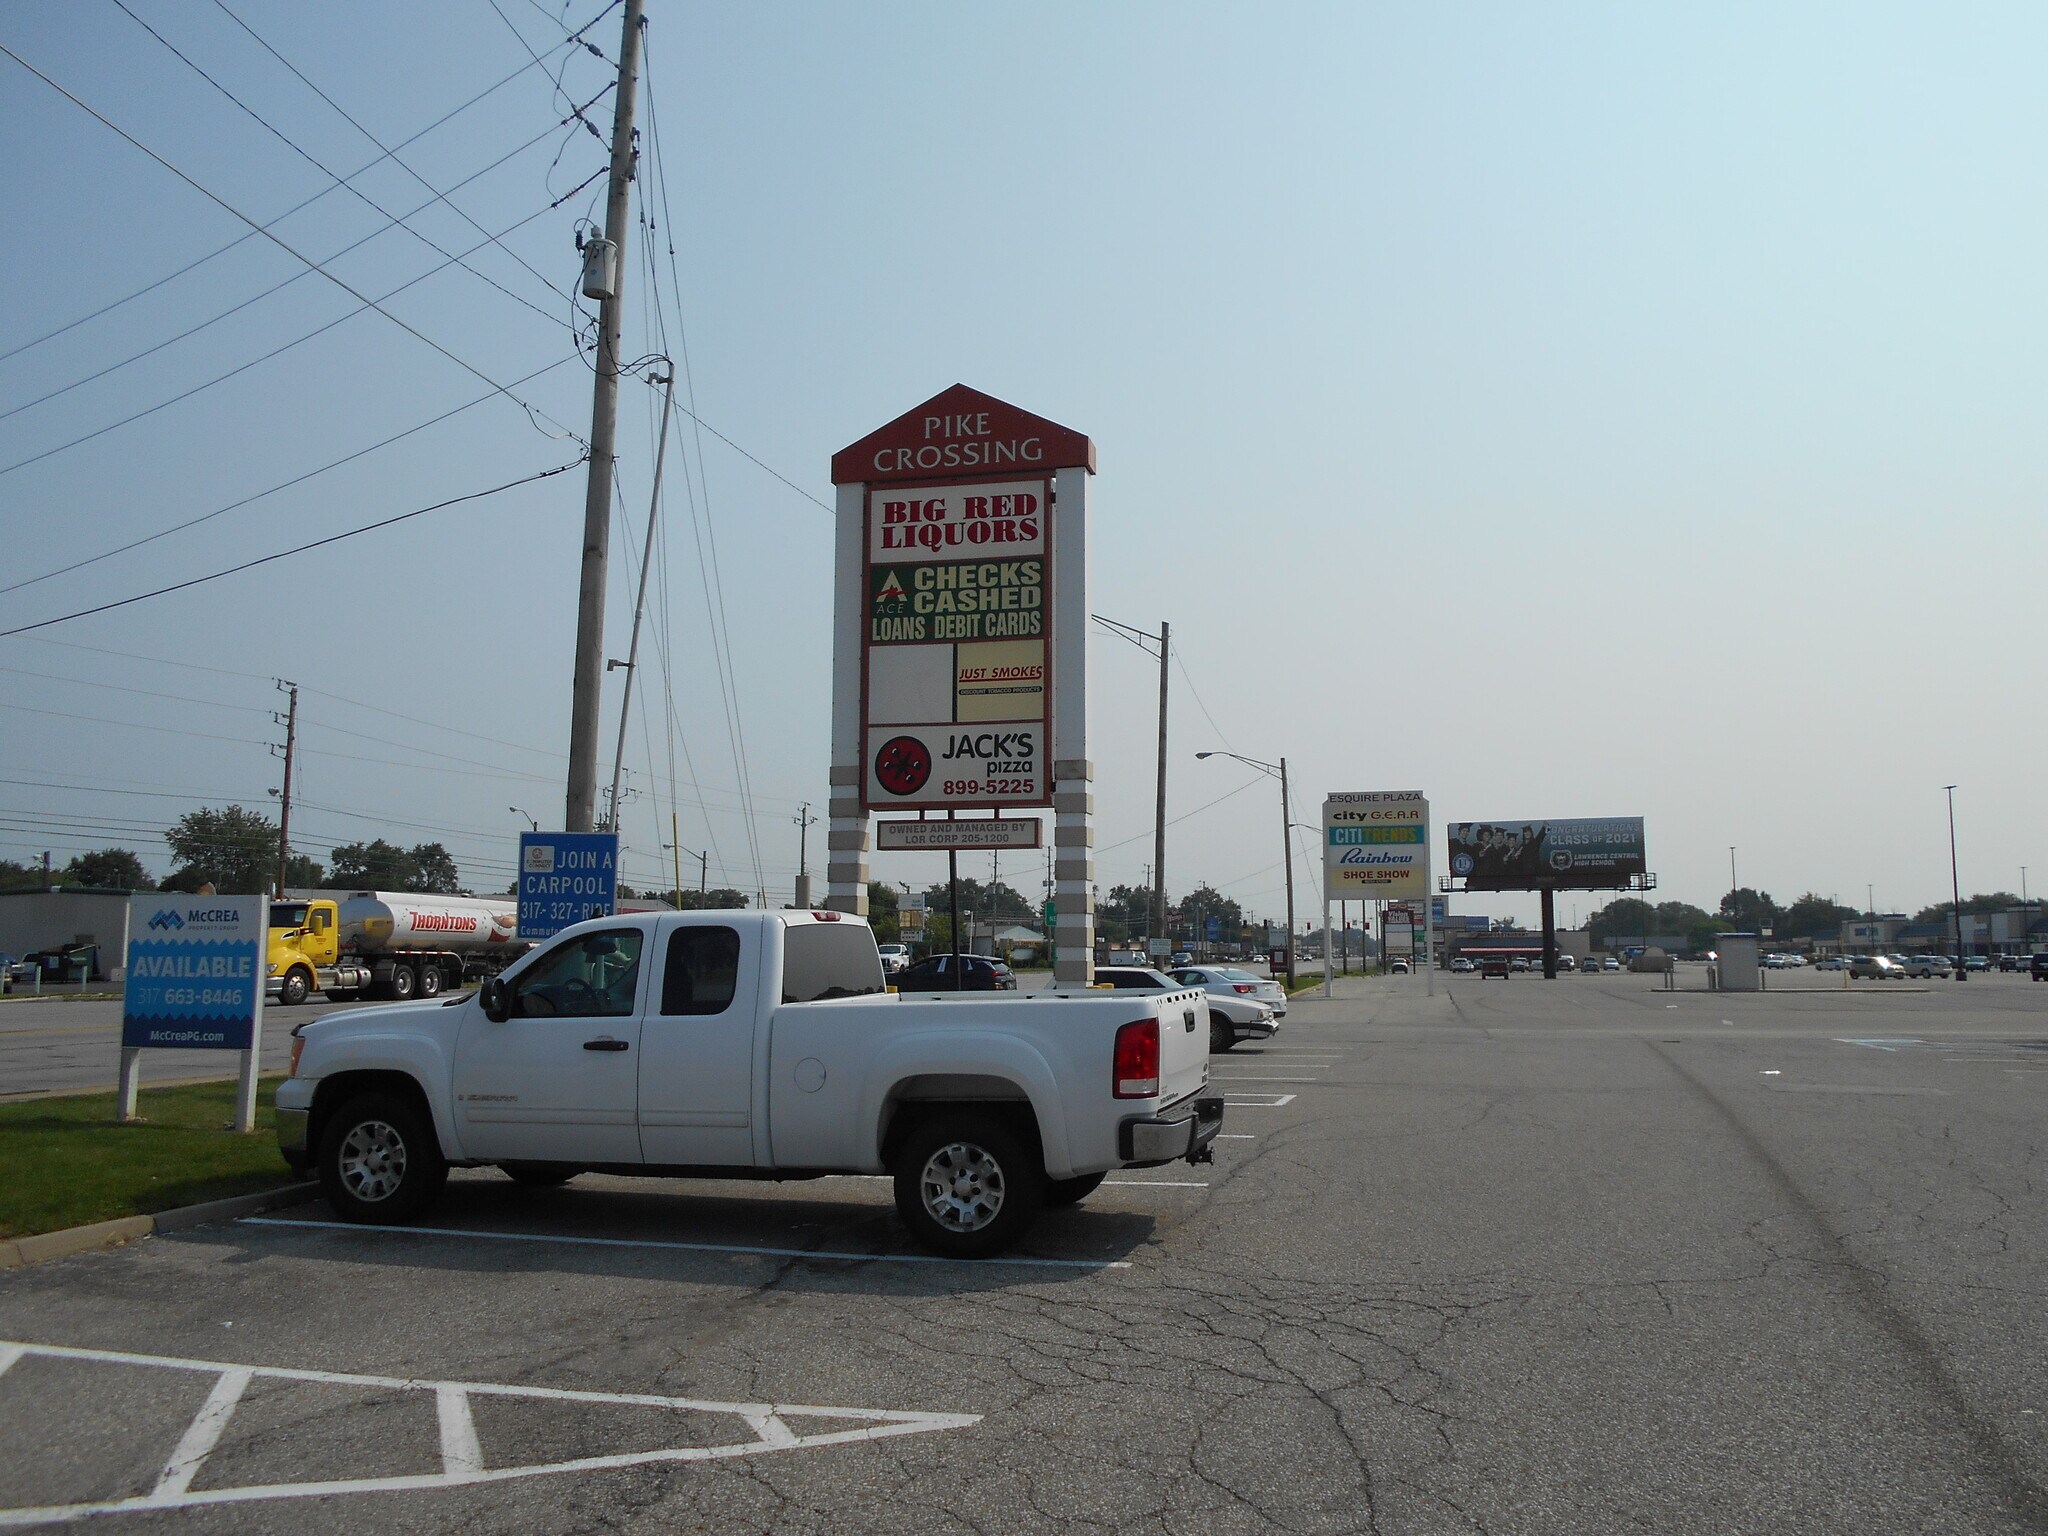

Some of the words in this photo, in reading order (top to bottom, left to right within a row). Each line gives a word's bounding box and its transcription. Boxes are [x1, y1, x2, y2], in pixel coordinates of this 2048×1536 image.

[925, 412, 991, 439] PIKE
[873, 438, 1042, 473] CROSSING
[883, 498, 946, 524] BIG
[963, 493, 1037, 519] RED
[881, 517, 1039, 552] LIQUORS
[914, 561, 1041, 590] CHECKS
[914, 586, 1041, 613] CASHED
[876, 604, 905, 614] ACE
[872, 617, 925, 641] LOANS
[935, 614, 981, 639] DEBIT
[985, 611, 1041, 636] CARDS
[959, 668, 987, 679] JUST
[992, 666, 1043, 679] SMOKES
[942, 733, 1034, 759] JACK'S
[987, 759, 1033, 777] pizza
[943, 778, 1034, 795] 899-5225
[1330, 794, 1379, 803] ESQUIRE
[1384, 793, 1421, 802] PLAZA
[1333, 811, 1367, 821] city
[889, 824, 927, 834] OWNED
[930, 824, 952, 833] AND
[956, 823, 1008, 833] MANAGED
[1012, 822, 1026, 832] BY
[1545, 823, 1639, 834] CONGRATULATIONS
[906, 835, 925, 844] LOR
[929, 834, 958, 843] CORP
[961, 833, 1009, 843] 205-1200
[1550, 834, 1589, 845] CLASS
[1606, 833, 1636, 844] 2021
[557, 851, 597, 869] JOIN
[602, 851, 612, 869] A
[1340, 848, 1412, 864] Rainbow
[1343, 871, 1373, 879] SHOE
[1377, 870, 1410, 879] SHOW
[526, 876, 607, 895] CARPOOL
[188, 909, 239, 922] McCREA
[410, 911, 477, 931] THORNTONS
[133, 956, 251, 978] AVAILABLE
[137, 988, 160, 1004] 317
[165, 988, 242, 1005] 663-8446
[150, 1031, 224, 1042] McCreaPG.com
